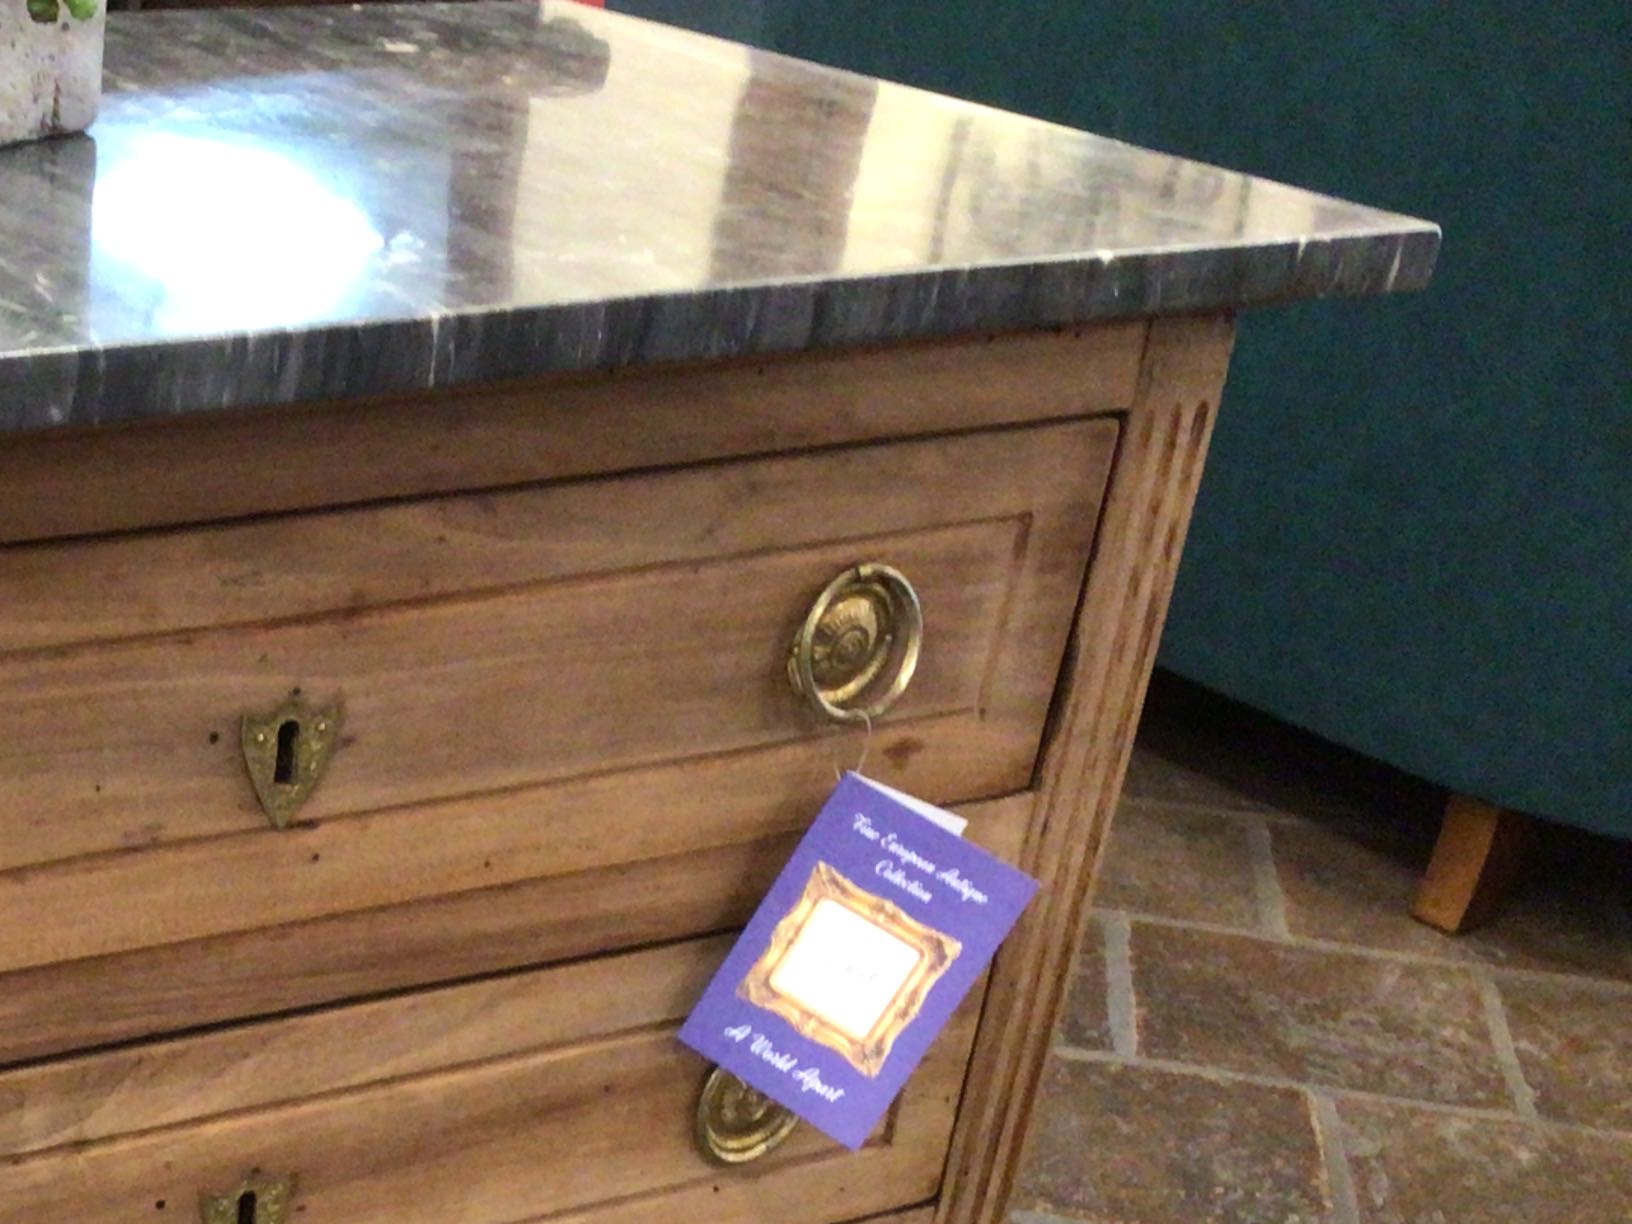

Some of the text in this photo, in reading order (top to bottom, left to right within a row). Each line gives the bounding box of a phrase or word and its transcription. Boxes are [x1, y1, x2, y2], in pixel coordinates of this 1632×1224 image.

[875, 859, 933, 904] Collection
[881, 833, 936, 874] European
[936, 868, 989, 904] Antique
[724, 1024, 845, 1102] A World Apart
